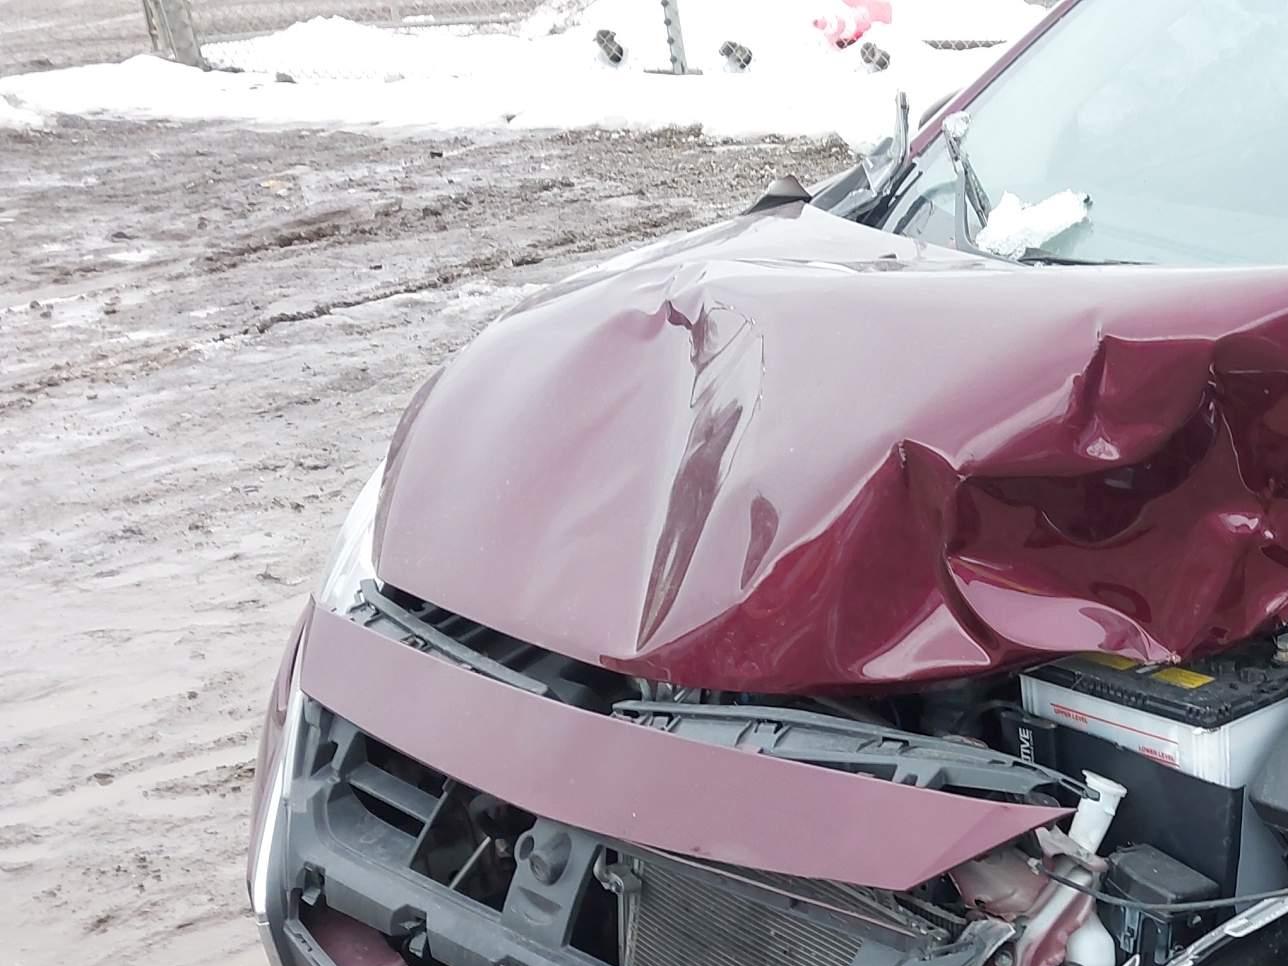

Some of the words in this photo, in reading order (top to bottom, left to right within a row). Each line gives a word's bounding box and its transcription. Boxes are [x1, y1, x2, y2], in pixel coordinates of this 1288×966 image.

[1071, 713, 1088, 724] LEVEL
[1138, 745, 1157, 756] LOWER
[1158, 751, 1175, 761] LEVEL
